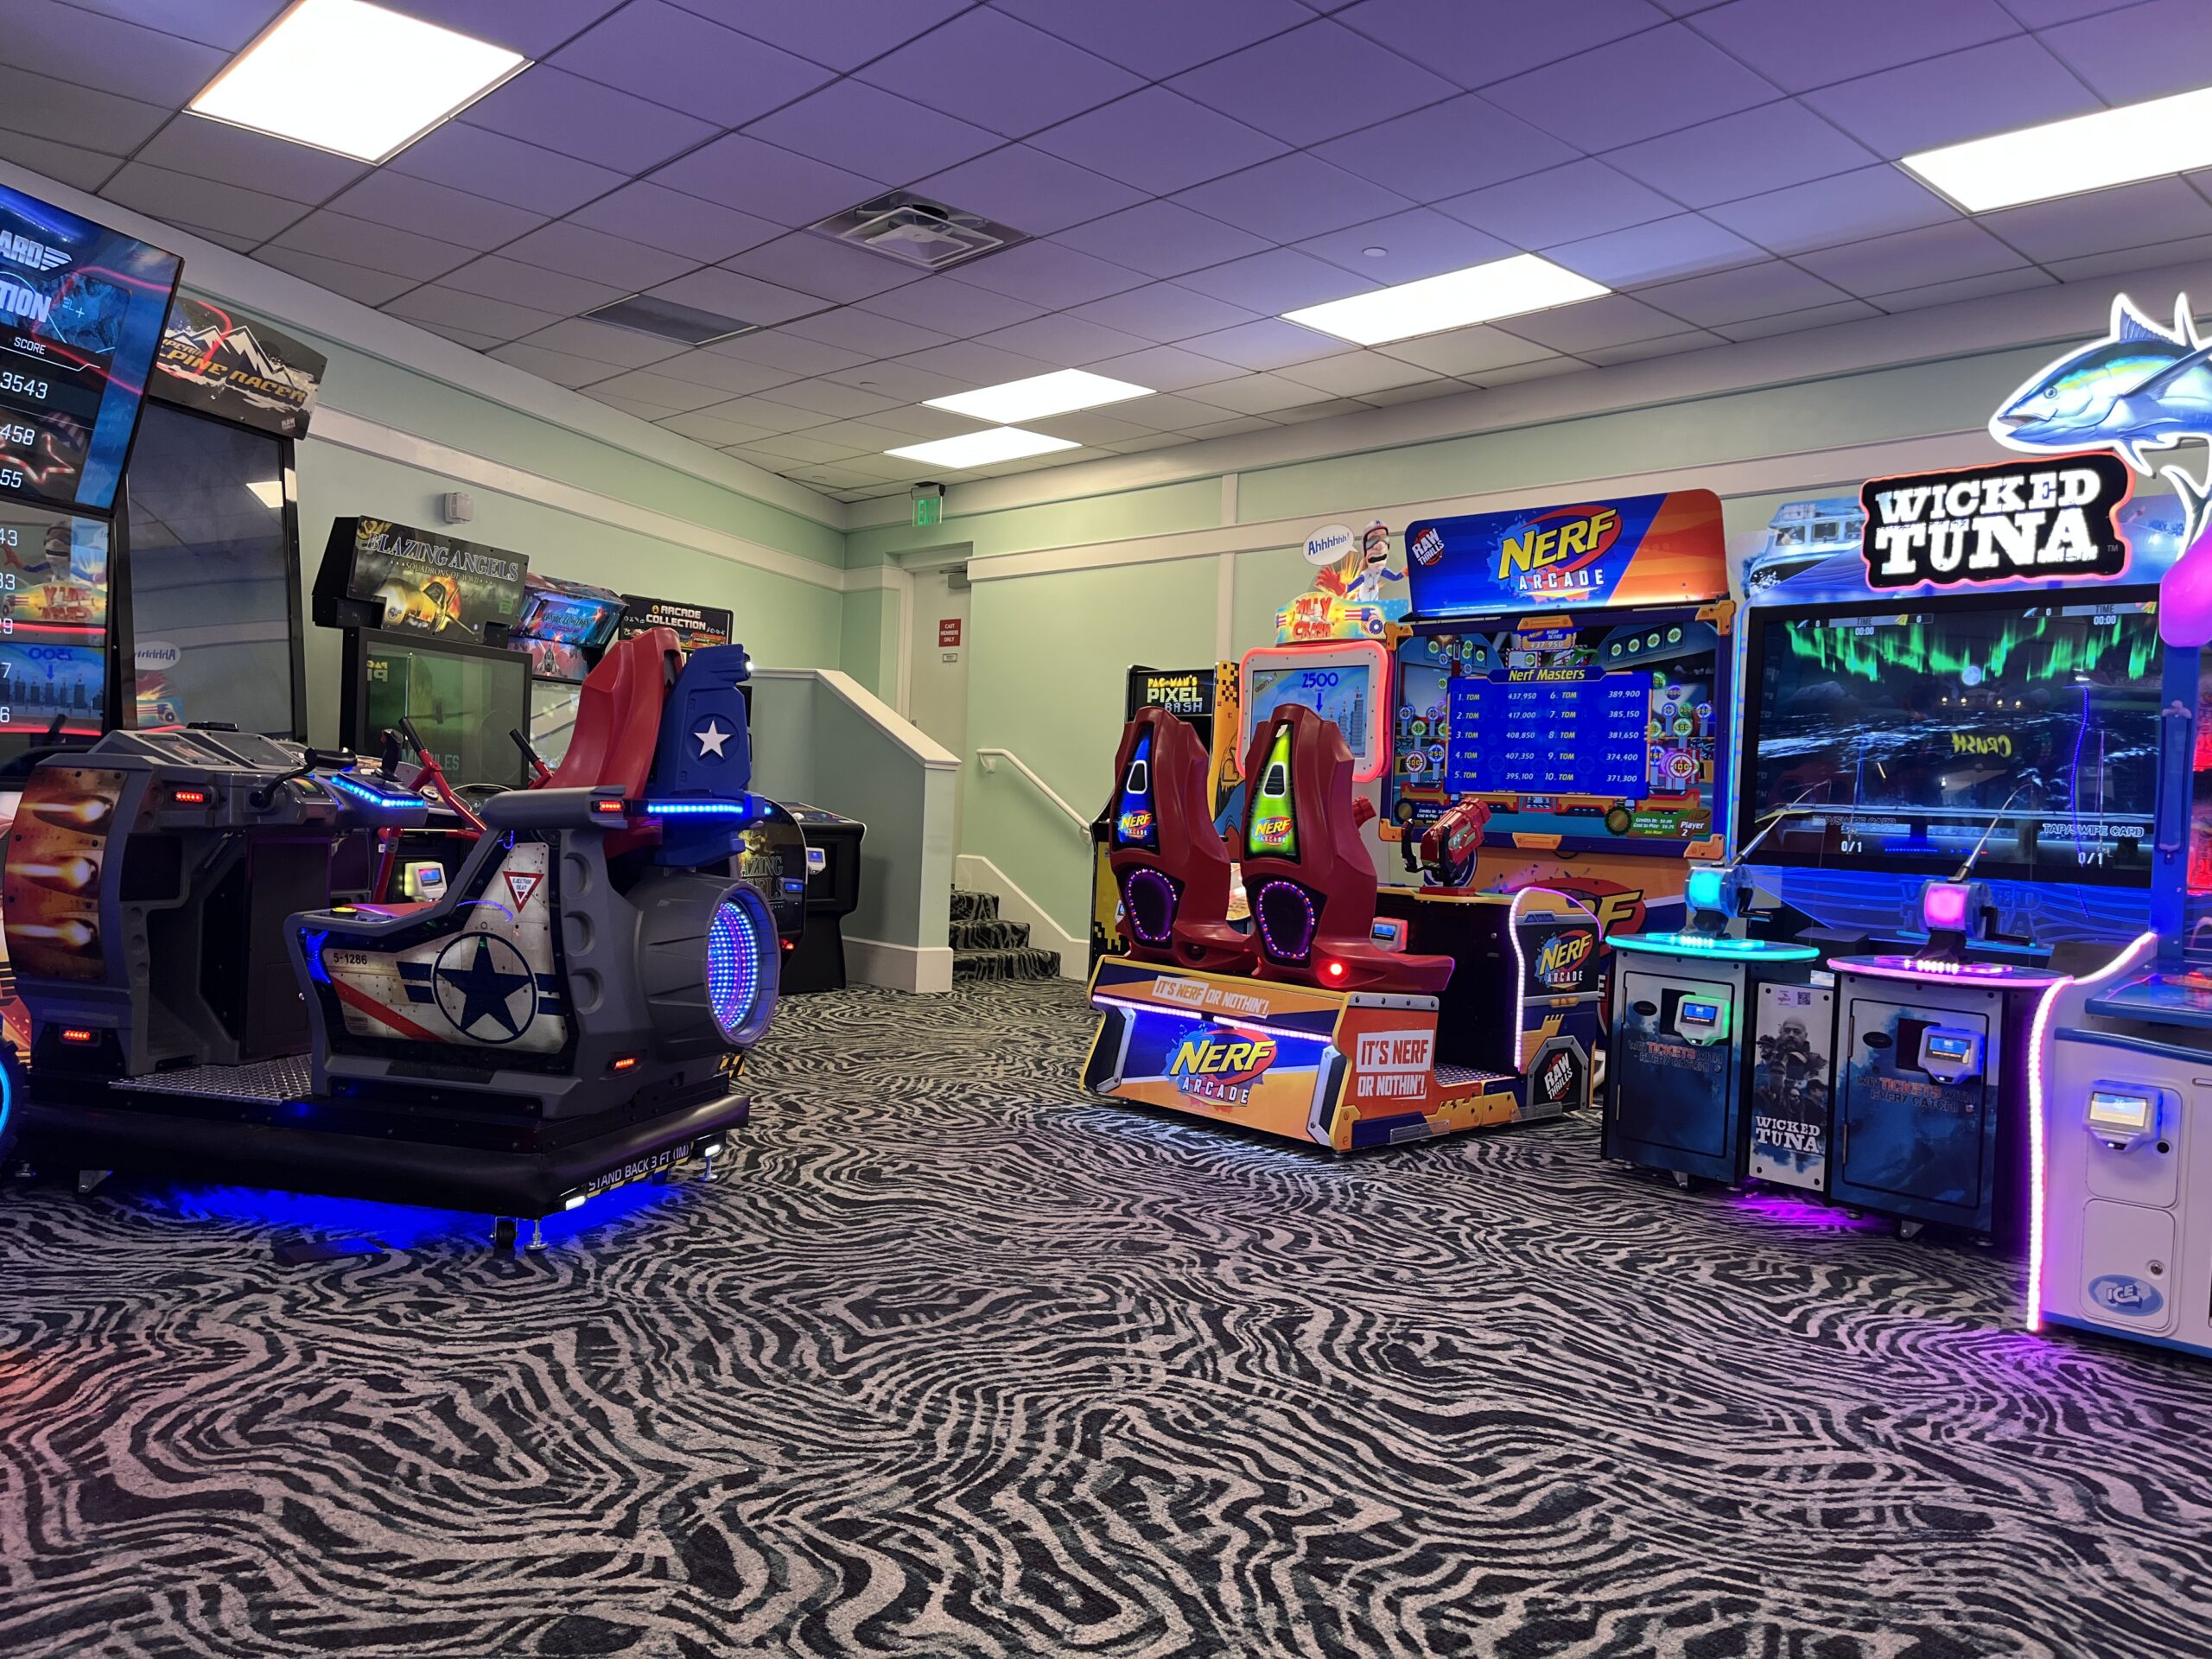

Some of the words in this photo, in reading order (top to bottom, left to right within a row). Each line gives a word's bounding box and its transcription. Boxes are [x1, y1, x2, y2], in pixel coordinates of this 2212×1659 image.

[14, 337, 46, 355] SCORE
[0, 372, 48, 399] 3543
[229, 370, 308, 403] RACER
[1875, 468, 2101, 524] WICKED
[918, 498, 939, 525] EXIT
[1411, 528, 1440, 559] RAW
[1497, 508, 1618, 580] NERF
[1875, 507, 2100, 575] TUNA
[2107, 544, 2119, 553] TM
[366, 532, 449, 566] BLAZING
[448, 550, 518, 582] ANGELS
[1417, 540, 1445, 566] THRILLS
[406, 563, 449, 577] SQUADRONS
[450, 571, 460, 581] OF
[1519, 569, 1605, 591] ARCADE
[661, 606, 701, 619] ARCADE
[2094, 605, 2114, 613] TIME
[646, 614, 707, 630] COLLECTION
[1858, 617, 1872, 626] TIME
[2094, 615, 2116, 625] 00:00
[1147, 675, 1198, 688] PAC-MAN'S
[1301, 672, 1338, 689] 2500
[1509, 670, 1535, 682] Nerf
[1537, 669, 1586, 681] Masters
[1147, 686, 1203, 703] PIXEL
[1608, 690, 1641, 699] 389,900
[1164, 702, 1203, 713] BASH
[1609, 710, 1639, 719] 385,150
[1121, 812, 1152, 830] NERF
[1255, 818, 1293, 837] NERF
[1680, 822, 1705, 831] Player
[2043, 823, 2108, 836] TAP/SWIPE
[2110, 826, 2145, 837] CARD
[1840, 841, 1862, 853] 0/1
[2078, 852, 2103, 865] 0/1
[334, 952, 367, 964] 5-1286
[1539, 933, 1592, 976] NERF
[1547, 970, 1583, 983] ARCADE
[1155, 981, 1177, 995] IT'S
[1177, 984, 1205, 1001] NERF
[1205, 989, 1219, 1005] OR
[1221, 992, 1269, 1015] NOTHIN'!
[1169, 1039, 1276, 1076] NERF
[1361, 1040, 1389, 1065] IT'S
[1392, 1039, 1429, 1065] NERF
[1647, 1041, 1697, 1059] TICKETS
[1543, 1052, 1571, 1090] RAW
[1181, 1076, 1250, 1105] ARCADE
[1357, 1076, 1374, 1096] OR
[1376, 1075, 1425, 1096] NOTHIN'!
[1548, 1067, 1573, 1101] THRILLS
[1858, 1075, 1880, 1088] WIN
[1880, 1077, 1942, 1099] TICKETS
[1871, 1089, 1910, 1103] EVERY
[1755, 1116, 1821, 1137] WICKED
[1755, 1128, 1820, 1154] TUNA
[588, 1171, 622, 1192] STAND
[625, 1159, 649, 1178] BACK
[651, 1156, 658, 1168] 3
[659, 1151, 671, 1166] FT
[672, 1144, 690, 1160] (1M)
[2107, 1284, 2143, 1309] ICE
